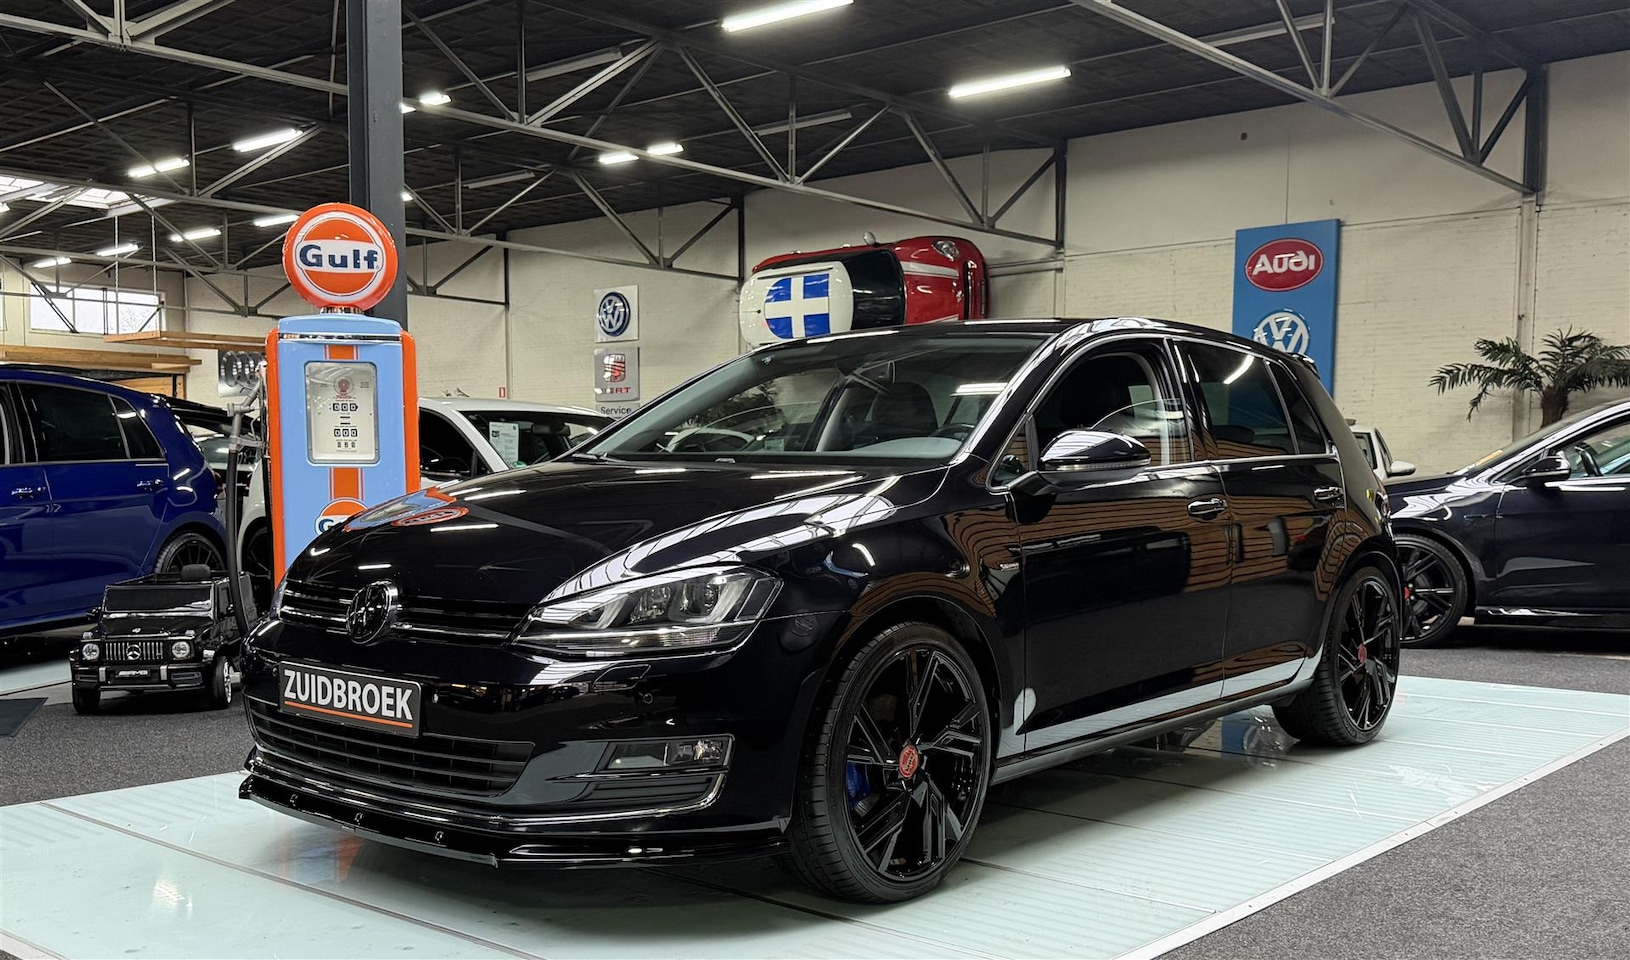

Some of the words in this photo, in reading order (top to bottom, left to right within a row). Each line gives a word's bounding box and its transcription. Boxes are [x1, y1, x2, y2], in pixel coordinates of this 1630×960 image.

[299, 244, 378, 269] Gulf
[600, 405, 632, 416] Service
[284, 669, 413, 721] ZUIDBROEK
